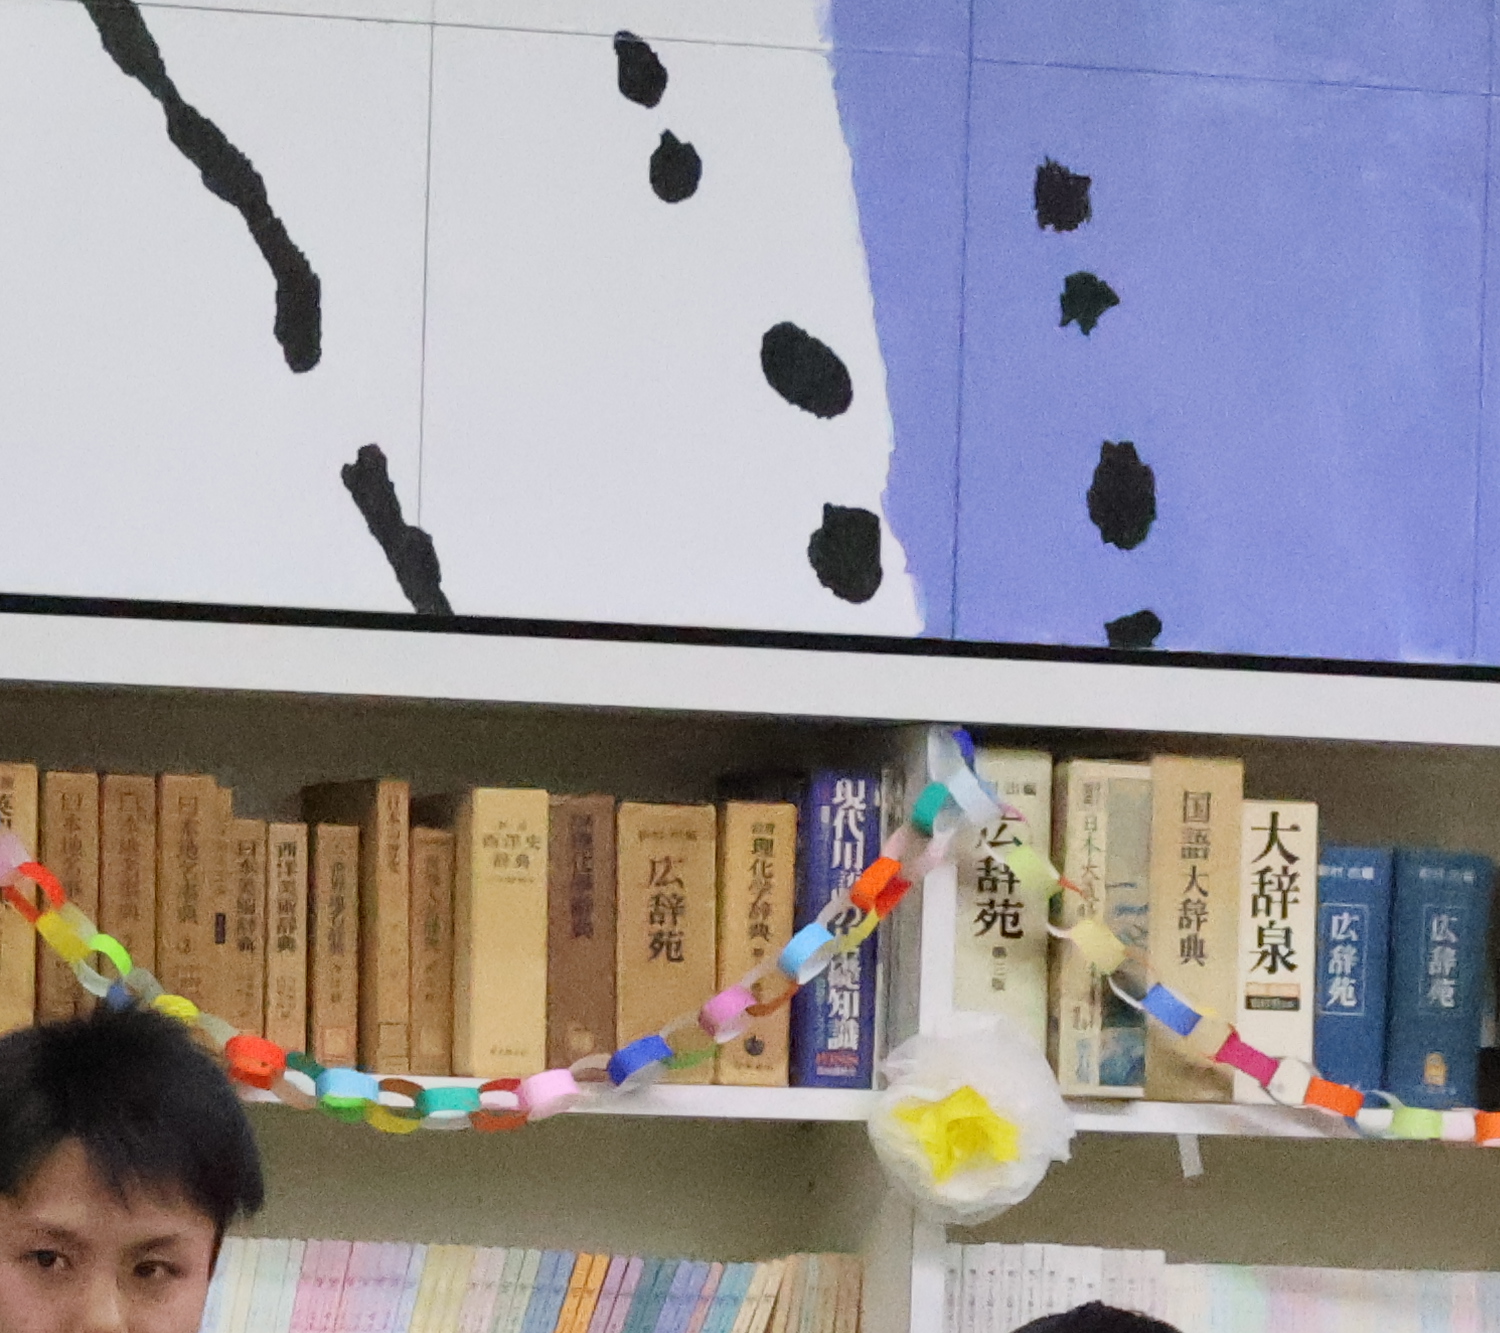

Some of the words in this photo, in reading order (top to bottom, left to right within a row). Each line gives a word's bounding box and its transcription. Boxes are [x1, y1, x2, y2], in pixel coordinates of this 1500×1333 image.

[647, 854, 686, 963] 広辞苑
[973, 813, 1025, 939] 広辞苑
[1177, 790, 1212, 967] 国語大辞典
[1249, 810, 1302, 975] 大辞泉
[1325, 911, 1361, 1008] 広辞苑
[1426, 913, 1460, 1008] 広辞苑
